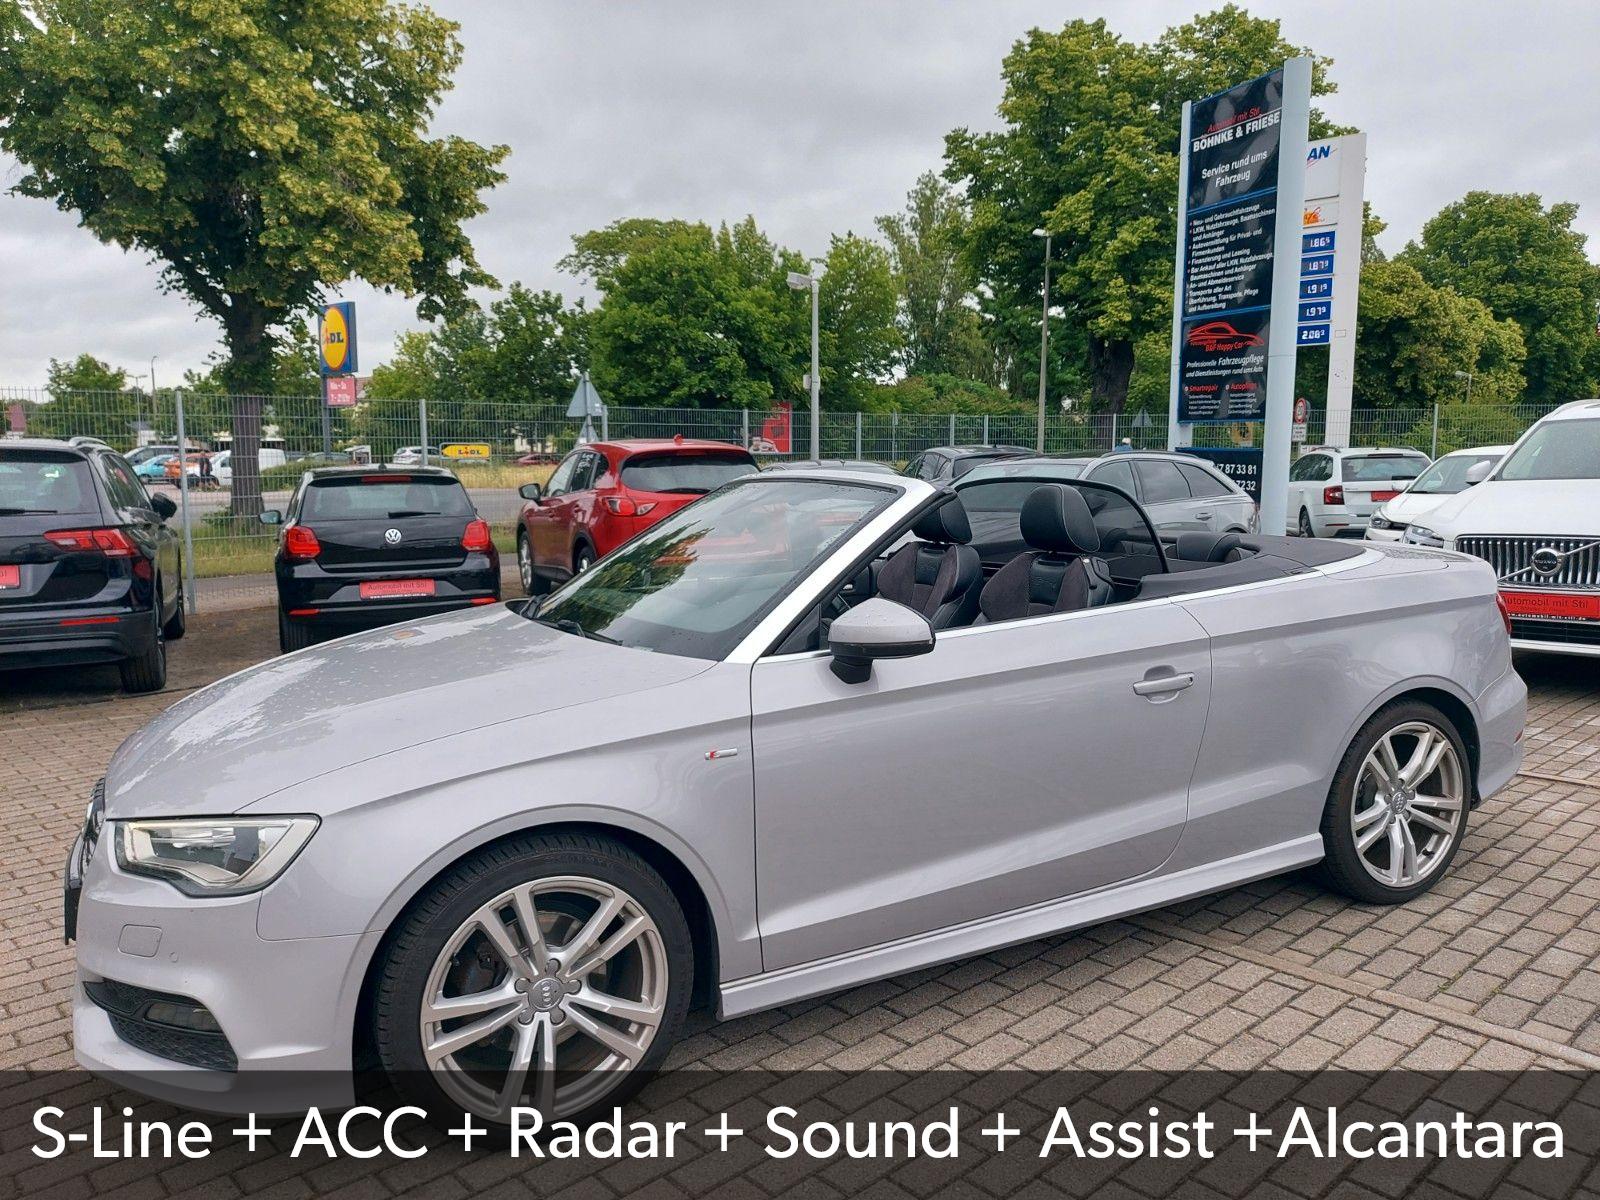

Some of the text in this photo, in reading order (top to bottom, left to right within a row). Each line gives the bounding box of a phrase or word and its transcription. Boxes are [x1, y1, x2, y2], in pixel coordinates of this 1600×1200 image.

[1236, 126, 1243, 138] &
[1246, 111, 1280, 134] FRIESE
[1307, 145, 1330, 160] AN
[1202, 150, 1268, 179] Service rund ums
[1216, 170, 1250, 188] Fahrzeug
[1218, 354, 1264, 366] Fahrzeugpflege
[1225, 464, 1236, 474] 87
[1236, 464, 1246, 474] 33
[1248, 464, 1257, 475] 81
[1502, 596, 1550, 606] Automobil
[1552, 598, 1568, 606] mit
[1572, 600, 1588, 608] Stil
